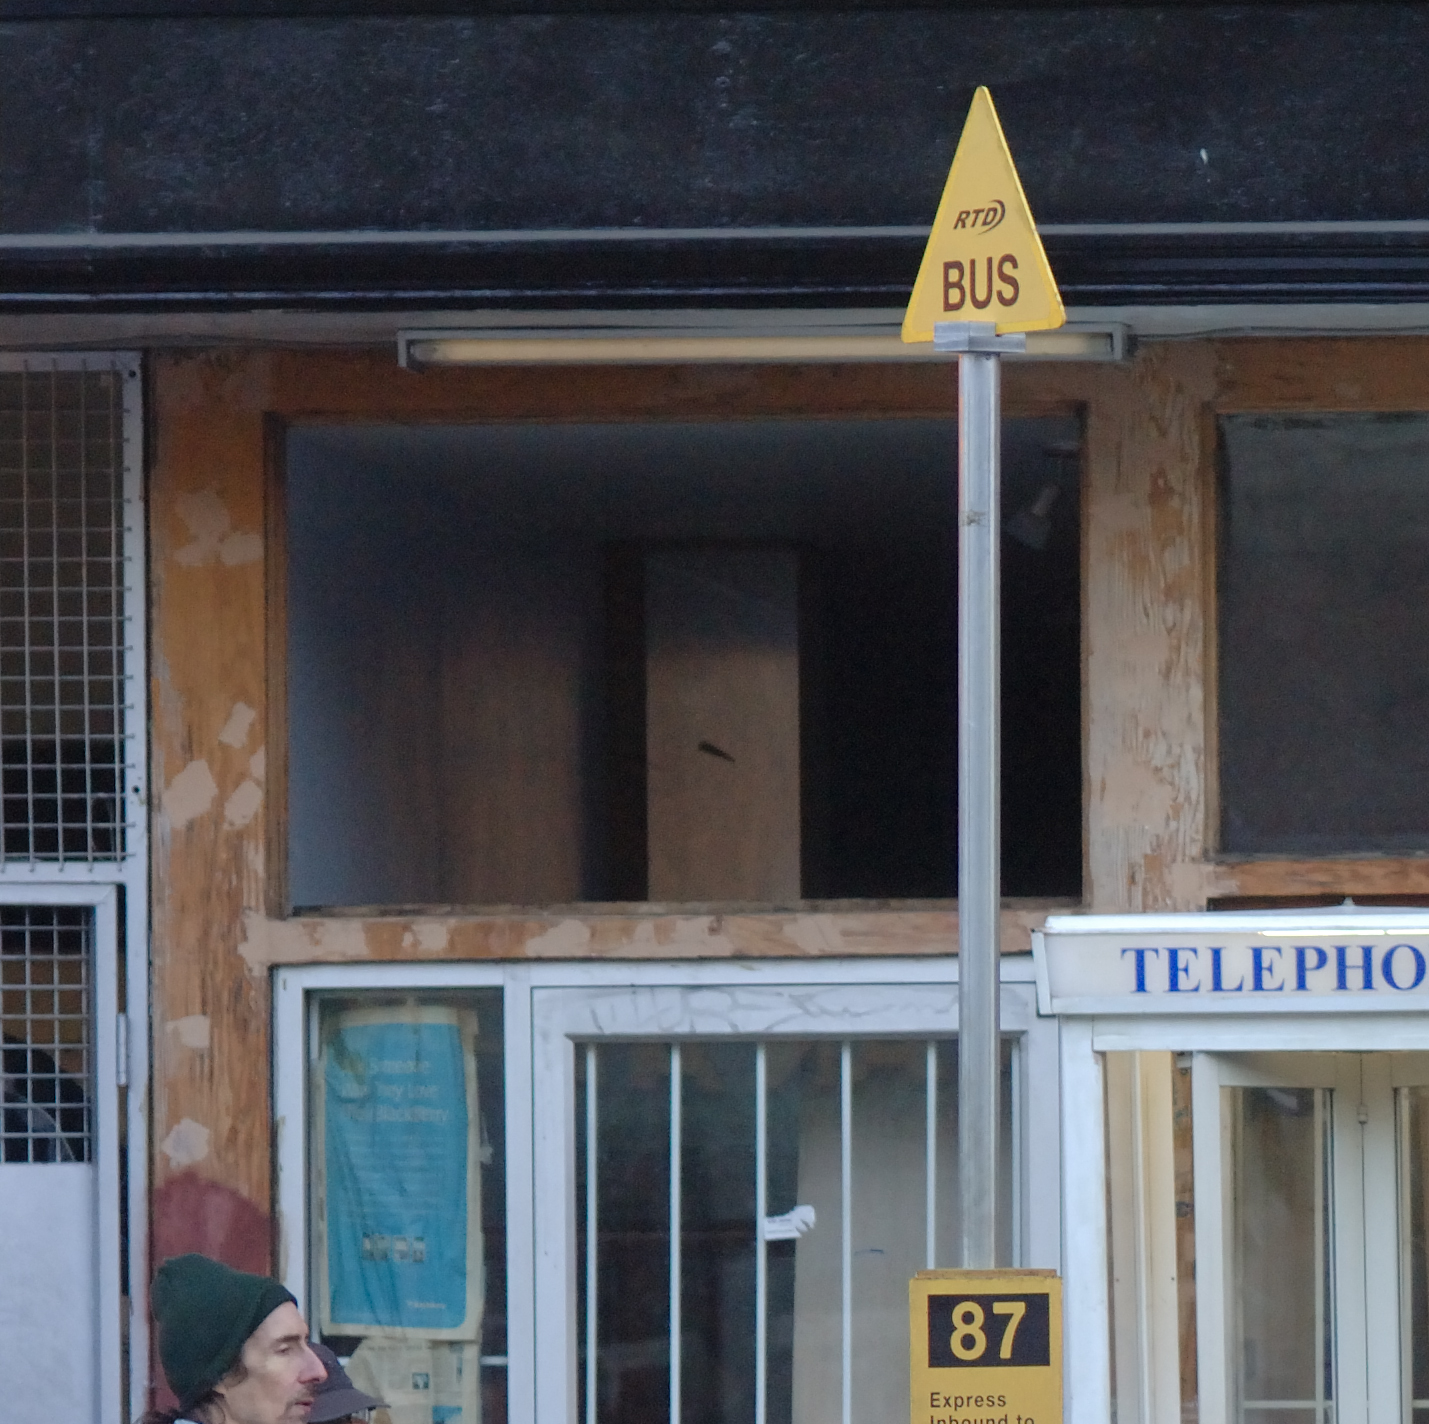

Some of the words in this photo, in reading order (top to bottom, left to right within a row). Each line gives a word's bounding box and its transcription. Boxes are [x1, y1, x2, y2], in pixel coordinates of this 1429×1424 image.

[953, 206, 999, 230] RTD
[942, 253, 1019, 312] BUS
[950, 1301, 1026, 1361] 87
[930, 1392, 1007, 1411] Express
